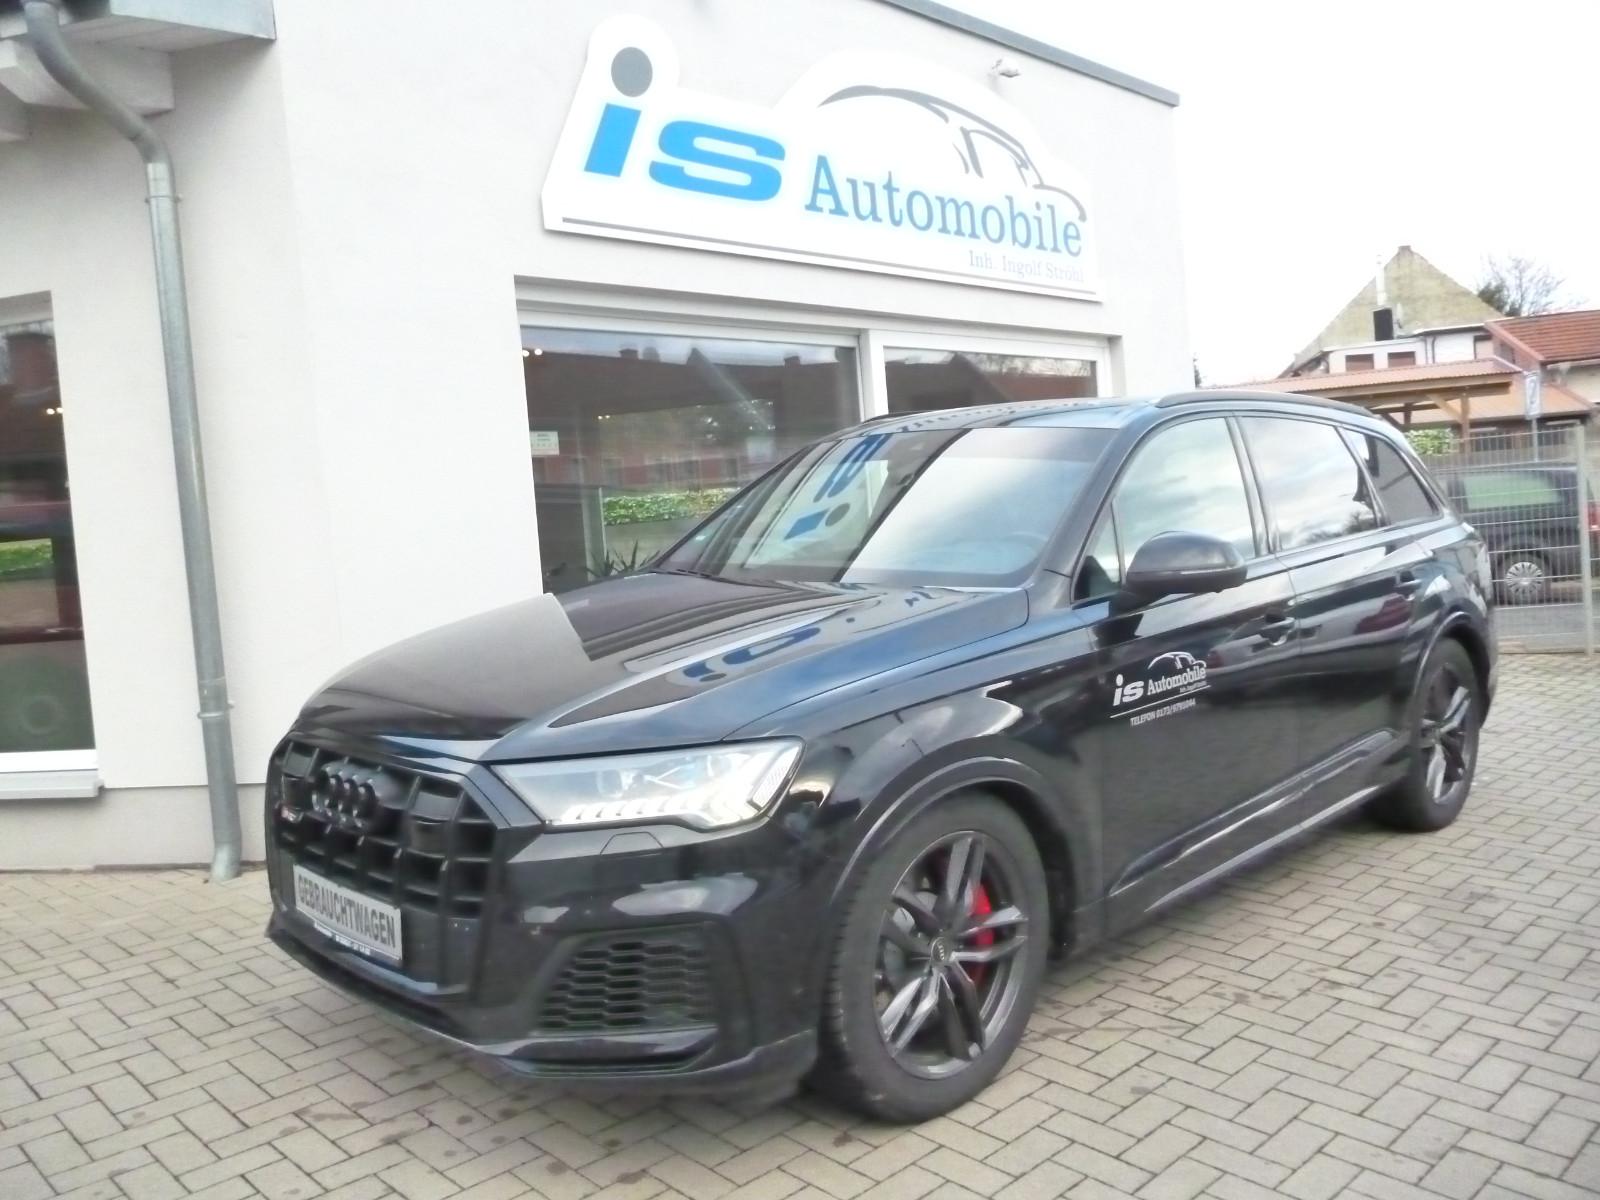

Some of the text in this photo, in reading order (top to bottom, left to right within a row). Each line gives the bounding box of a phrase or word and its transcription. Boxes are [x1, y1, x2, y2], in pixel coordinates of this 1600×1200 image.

[584, 47, 1082, 257] is Automobile
[1002, 255, 1042, 279] Ingolf
[1113, 665, 1207, 707] is Automobile
[1130, 711, 1156, 727] TELEFON
[298, 874, 396, 948] GEBRAUCHTWAGEN
